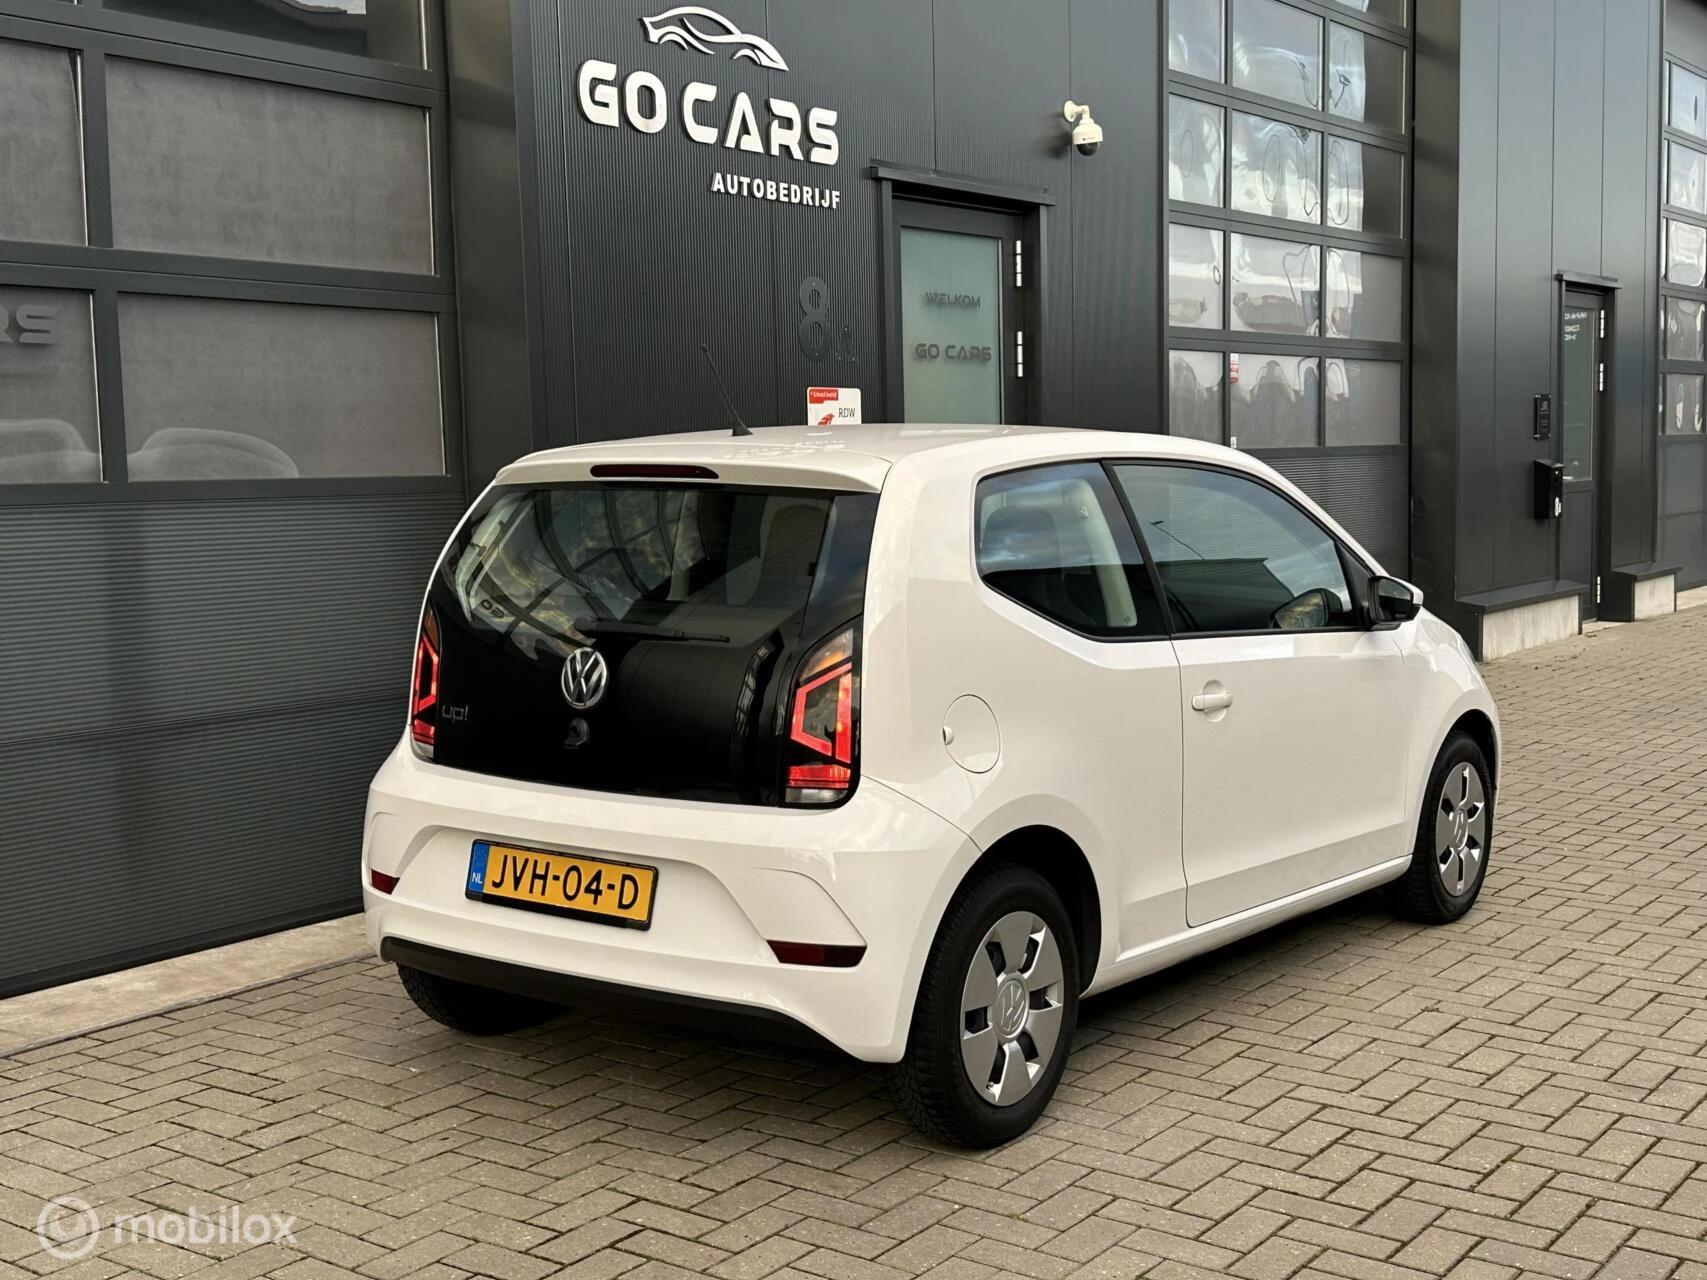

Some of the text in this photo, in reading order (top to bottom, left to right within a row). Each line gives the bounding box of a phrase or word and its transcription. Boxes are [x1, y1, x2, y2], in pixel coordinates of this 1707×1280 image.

[578, 59, 839, 166] GO CARS
[711, 172, 840, 209] AUTOBEDRIJF
[924, 291, 981, 308] WELKOM
[915, 343, 992, 362] GO CARS
[838, 407, 856, 418] RDW
[442, 704, 469, 724] up!
[471, 871, 483, 885] NL
[491, 854, 639, 911] JVH-04-D
